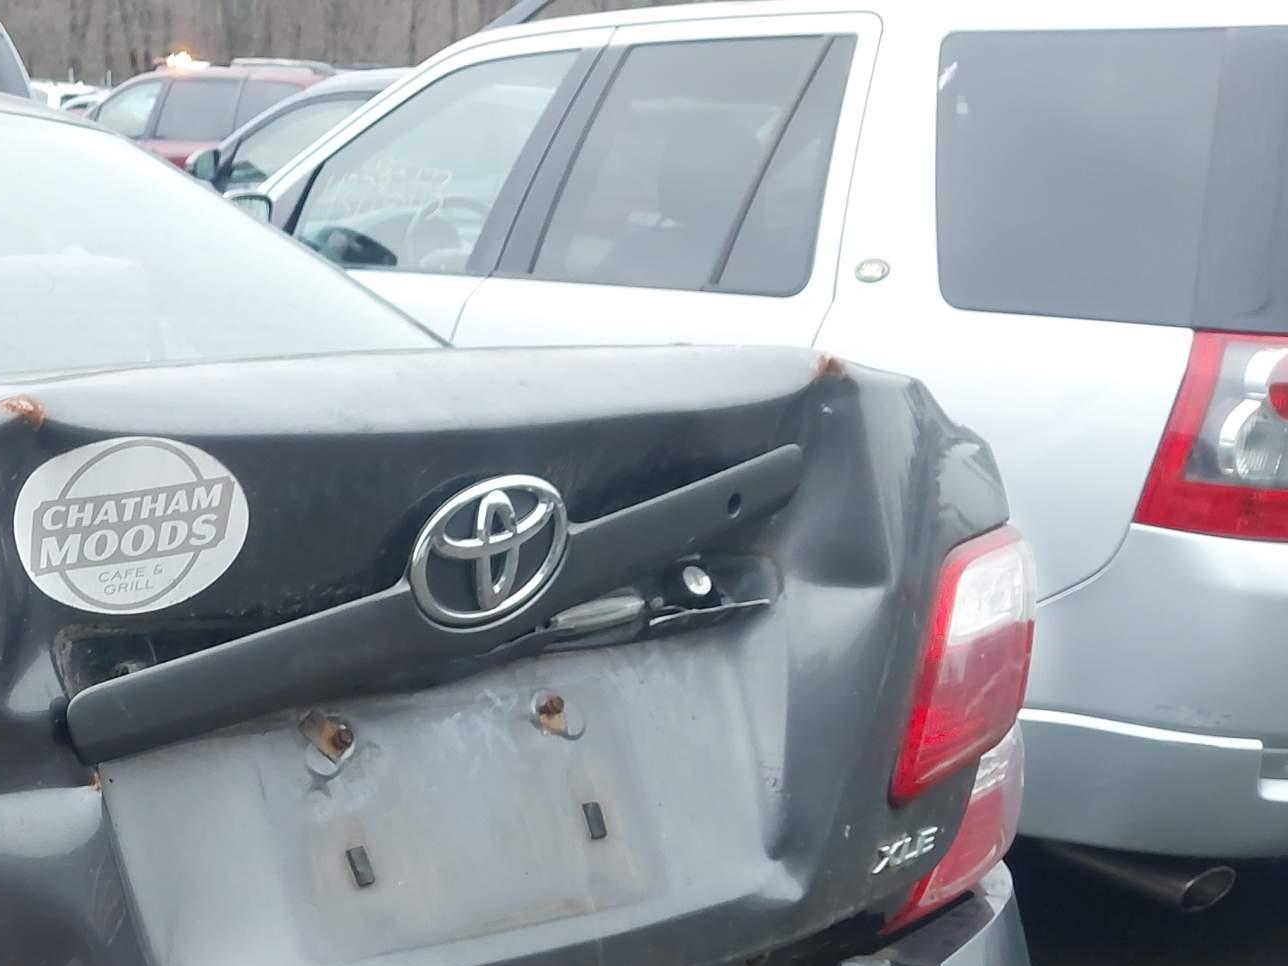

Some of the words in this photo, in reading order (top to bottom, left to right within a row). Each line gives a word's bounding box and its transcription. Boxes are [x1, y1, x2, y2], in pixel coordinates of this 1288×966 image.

[41, 483, 224, 531] CHATHAM
[39, 513, 218, 570] MOODS
[98, 565, 145, 583] CAFE
[153, 563, 163, 575] &
[103, 579, 155, 595] GRILL
[871, 826, 938, 875] XLE
